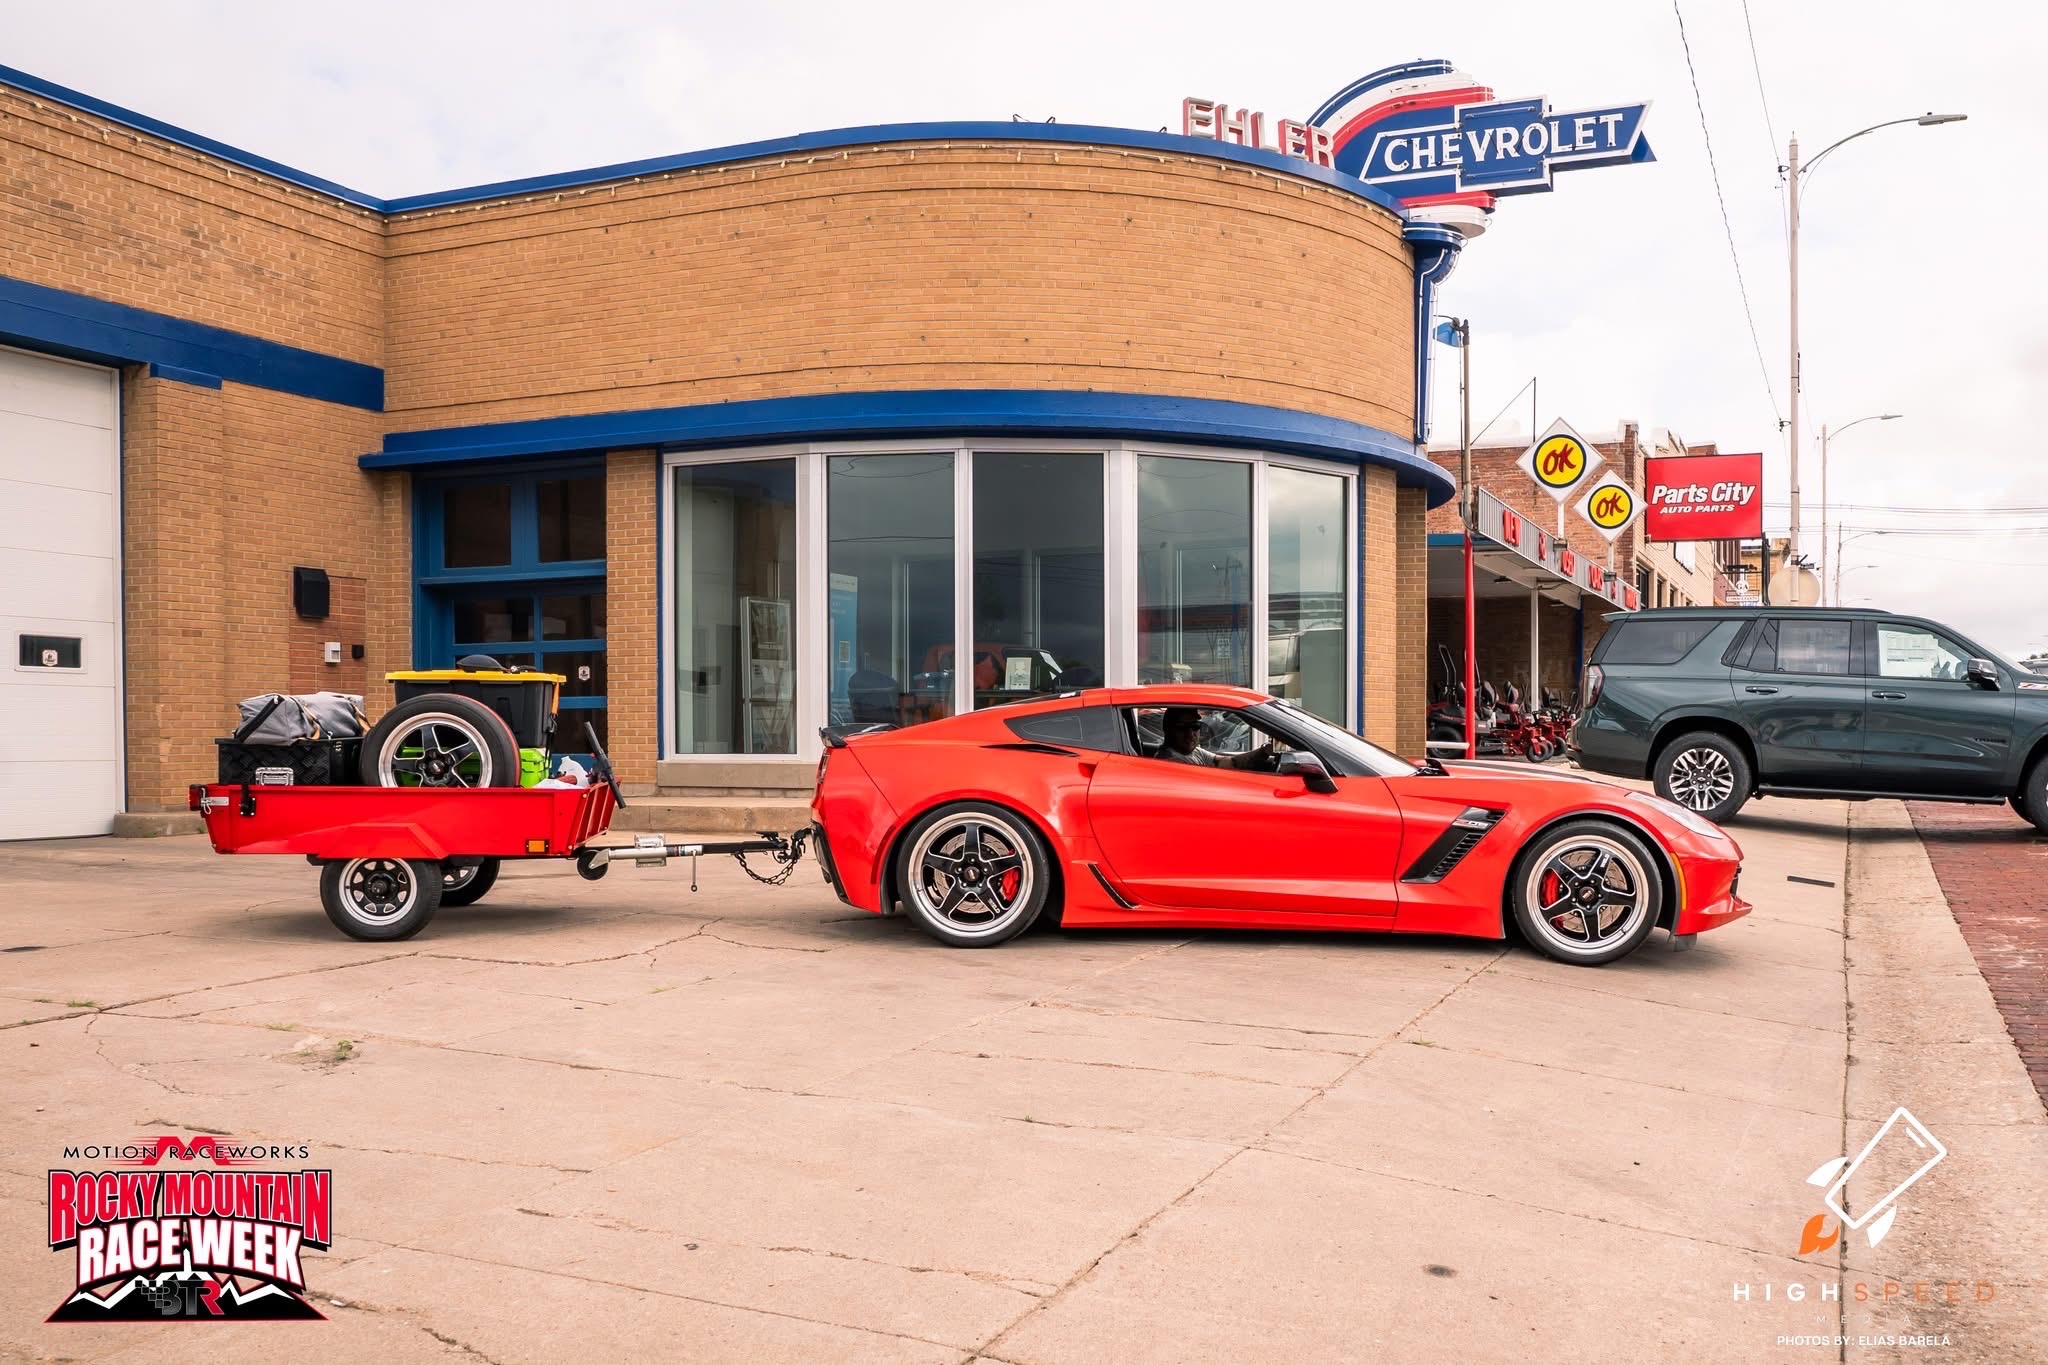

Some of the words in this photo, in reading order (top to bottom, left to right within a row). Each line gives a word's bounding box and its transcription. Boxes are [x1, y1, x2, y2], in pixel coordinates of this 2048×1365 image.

[1183, 97, 1336, 170] EHLER
[1384, 113, 1623, 173] CHEVROLET
[1543, 443, 1576, 475] OK
[1596, 492, 1624, 518] OK
[1651, 484, 1708, 505] Parts
[1711, 482, 1756, 506] City
[1660, 506, 1692, 514] AUTO
[1695, 504, 1735, 513] PARTS
